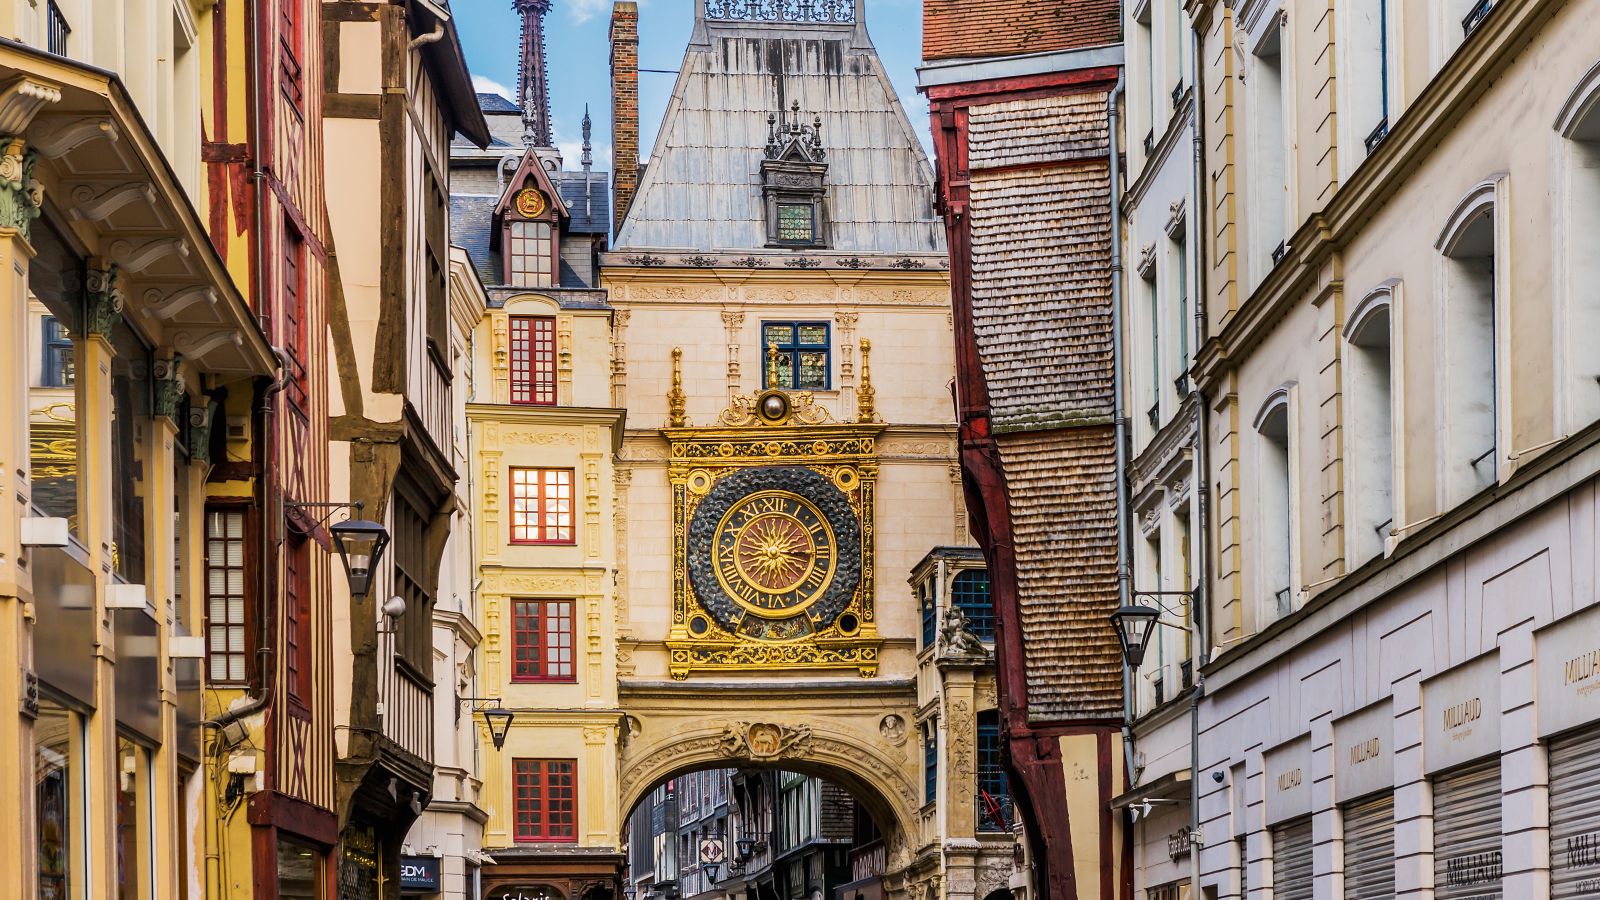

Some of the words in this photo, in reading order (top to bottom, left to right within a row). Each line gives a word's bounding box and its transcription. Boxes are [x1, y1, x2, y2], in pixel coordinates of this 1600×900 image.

[739, 502, 759, 521] XI
[762, 498, 784, 512] XII
[793, 504, 802, 517] I
[724, 521, 741, 538] X
[808, 521, 823, 534] II
[720, 545, 734, 562] IX
[816, 545, 829, 559] III
[722, 565, 742, 592] VIII
[807, 566, 826, 588] IIII
[740, 586, 761, 605] VII
[768, 594, 786, 608] VI
[795, 589, 808, 603] V
[1565, 649, 1600, 686] MILLIA
[1443, 697, 1482, 732] MILLIAUD
[1350, 737, 1380, 766] MILLIAUD
